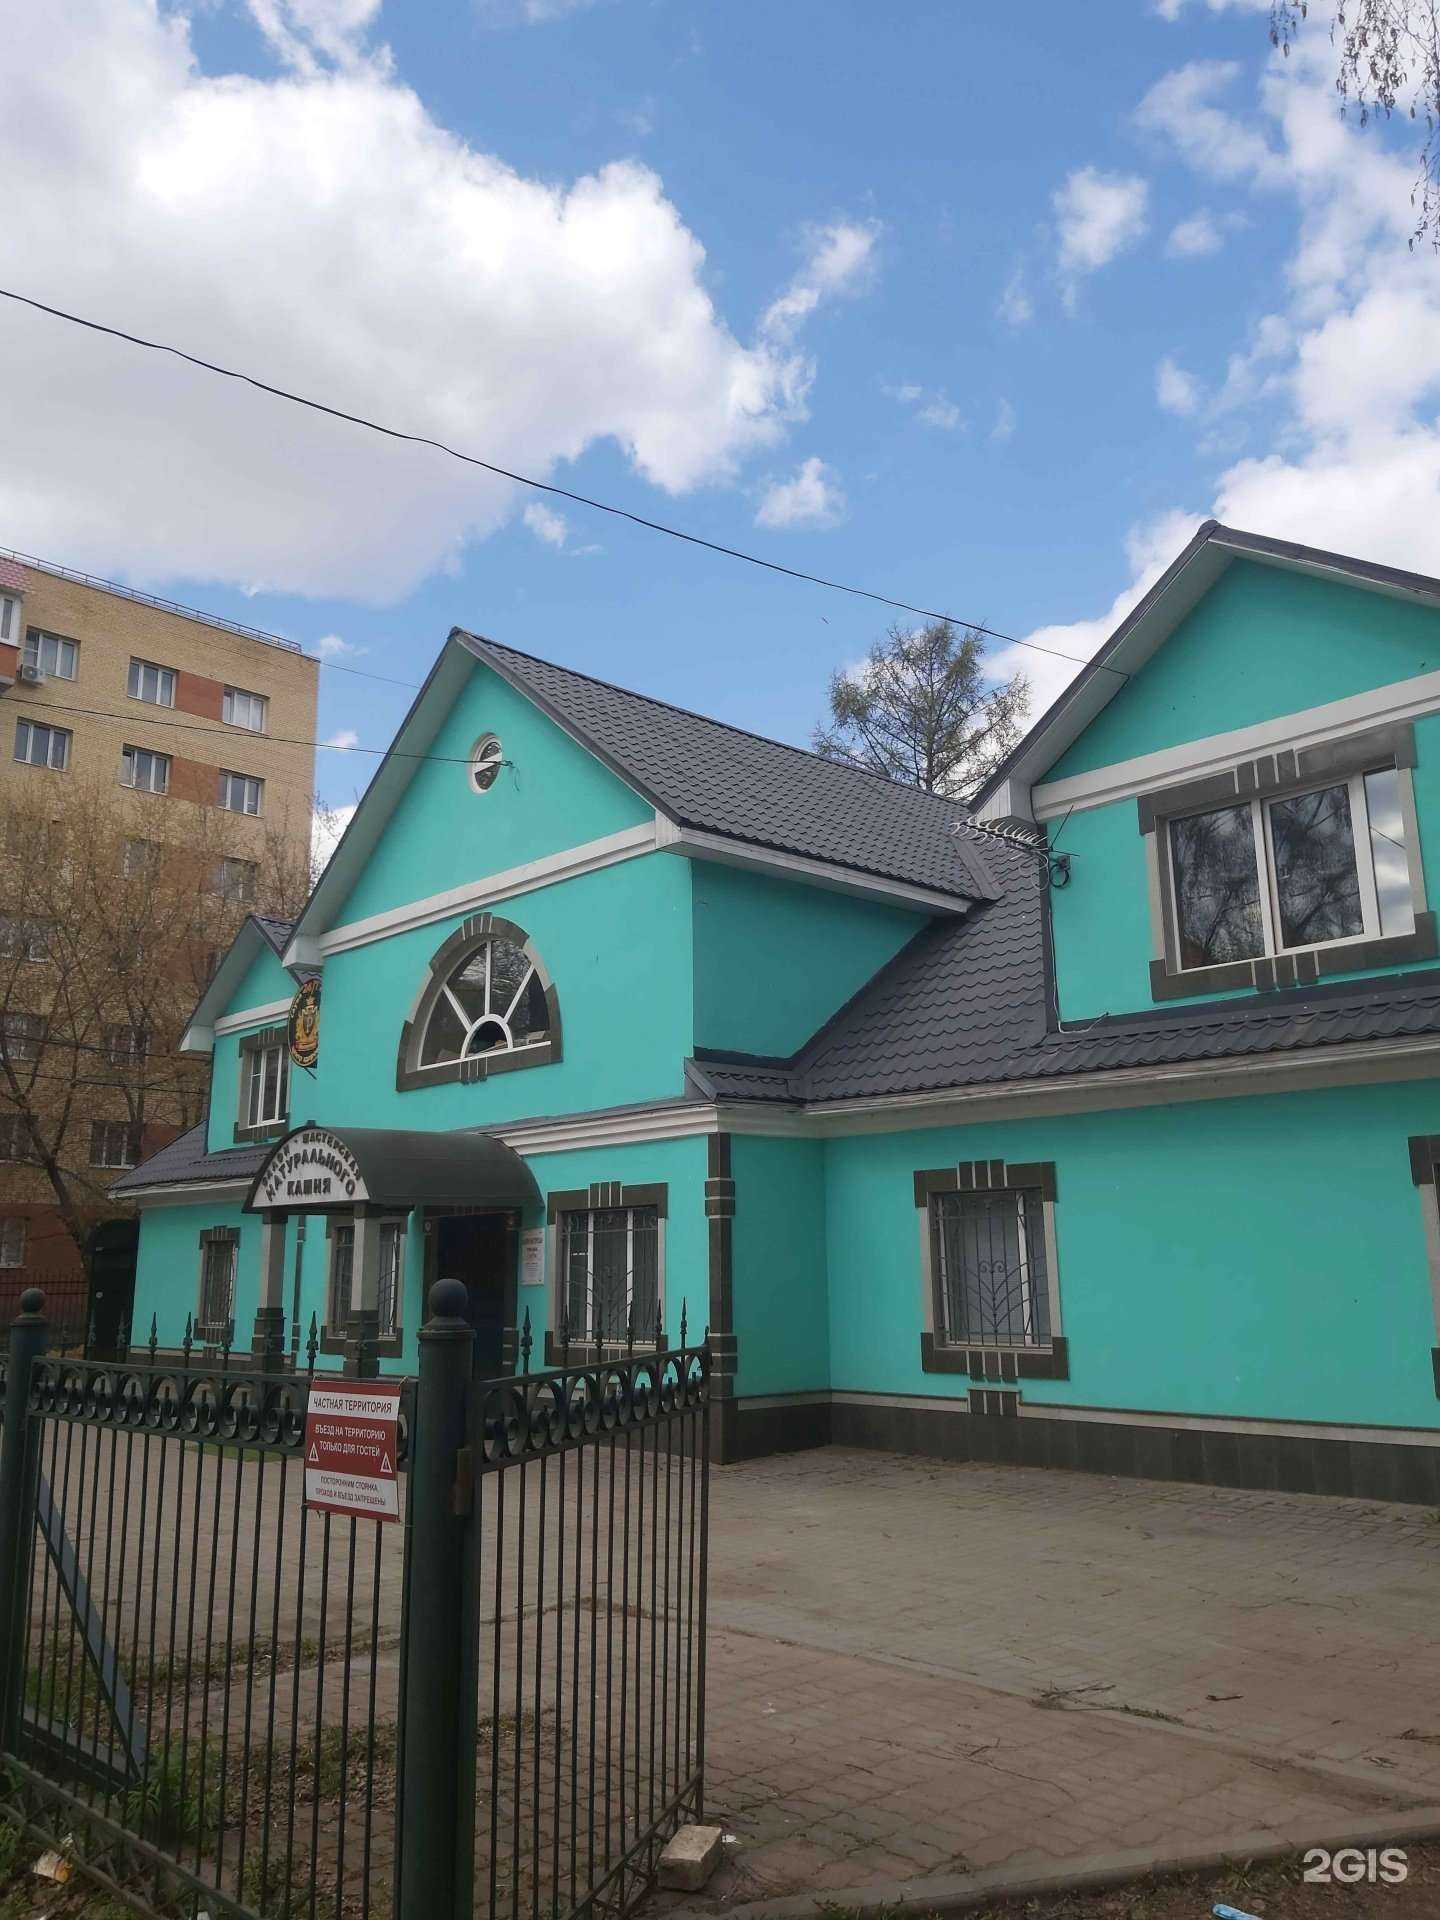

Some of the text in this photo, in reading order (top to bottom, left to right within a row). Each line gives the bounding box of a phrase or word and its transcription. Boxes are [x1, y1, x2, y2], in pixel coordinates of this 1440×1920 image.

[266, 1148, 356, 1201] НАТУРАЛЬНОГО
[287, 1178, 331, 1197] КАМНЯ
[313, 1397, 392, 1414] ЧАСТНАЯ ТЕРРИТОРИЯ
[315, 1424, 386, 1440] ВЪЕЗД НА ТЕРРИТОРИЮ
[320, 1440, 380, 1457] ТОЛЬКО ДЛЯ ГОСТЕЙ
[320, 1476, 355, 1488] ПОСТОРОННИМ
